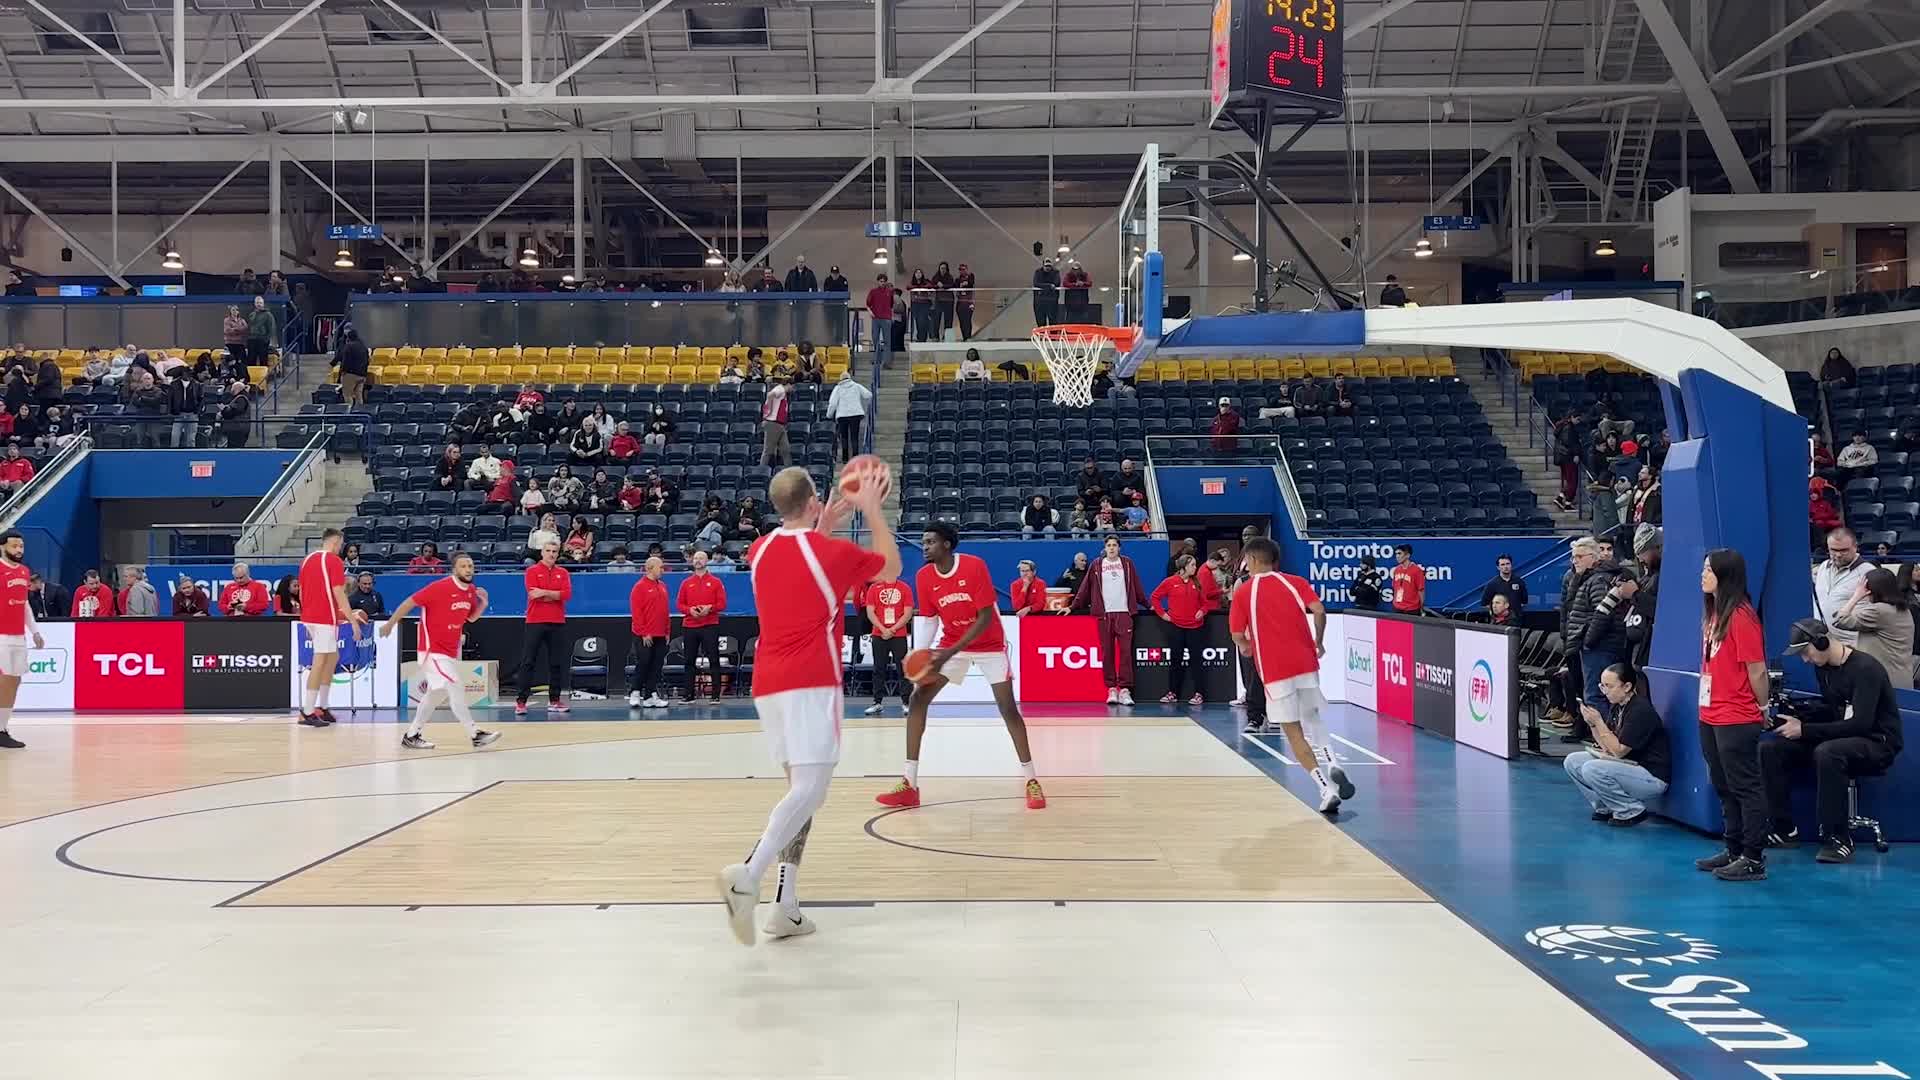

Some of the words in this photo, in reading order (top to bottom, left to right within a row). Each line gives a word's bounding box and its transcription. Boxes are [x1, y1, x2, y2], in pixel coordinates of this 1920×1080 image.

[1268, 25, 1325, 88] 24
[1308, 541, 1394, 560] Toronto
[938, 592, 973, 607] CANADA
[29, 657, 57, 673] art
[92, 653, 165, 676] TCL
[217, 654, 283, 667] TISSOT
[1037, 645, 1104, 669] TCL
[1382, 652, 1408, 686] TCL
[1425, 664, 1453, 687] TISSOT
[1615, 974, 1809, 1052] Sun
